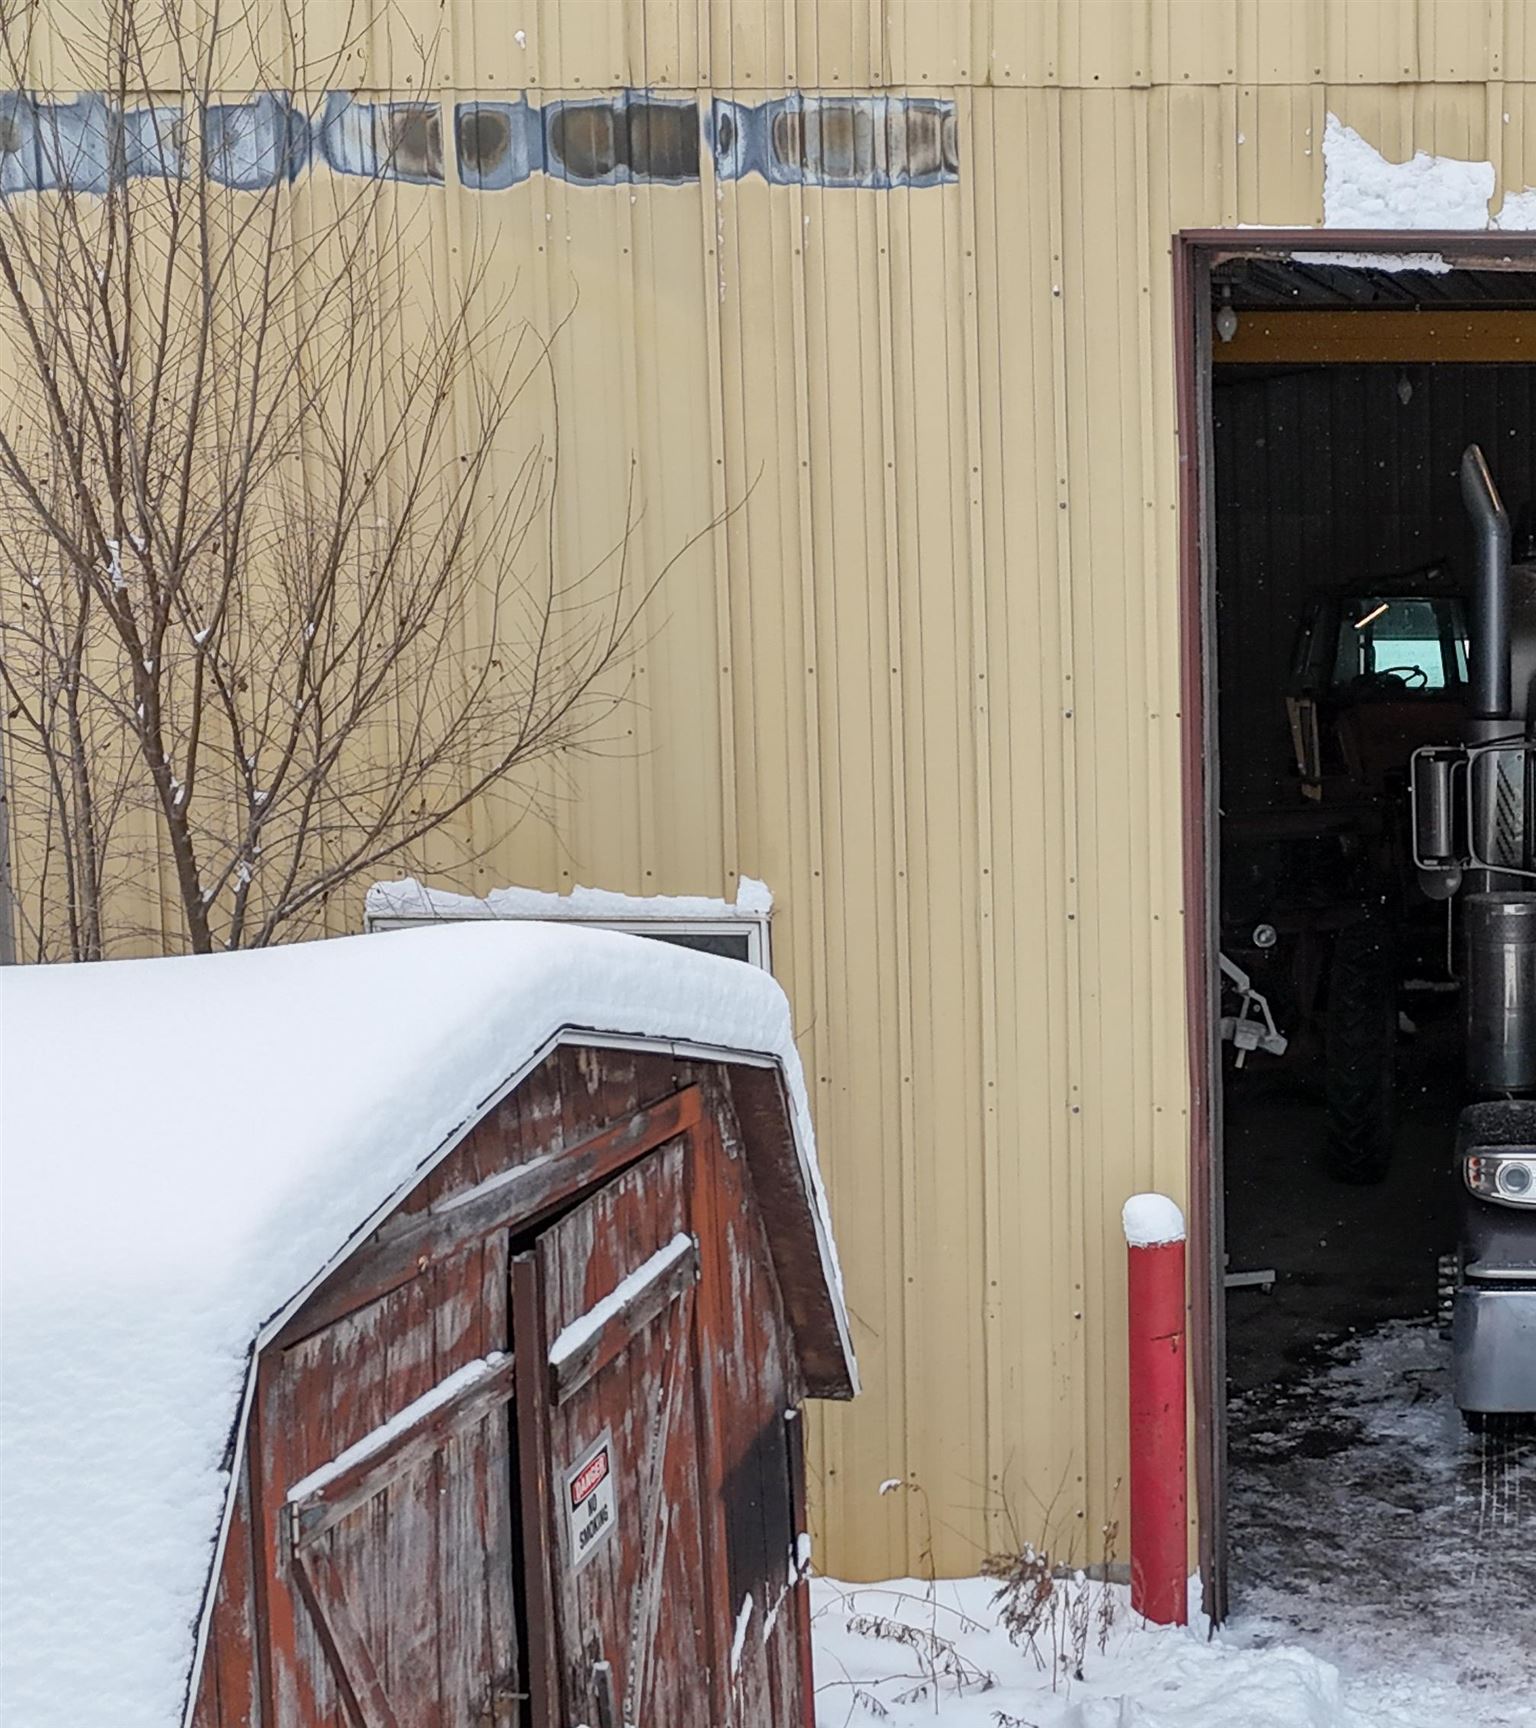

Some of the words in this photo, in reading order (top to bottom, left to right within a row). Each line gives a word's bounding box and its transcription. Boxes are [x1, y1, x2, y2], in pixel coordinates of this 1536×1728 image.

[574, 1456, 605, 1499] DANGER
[588, 1493, 597, 1516] NO
[579, 1503, 609, 1550] SMOKING
